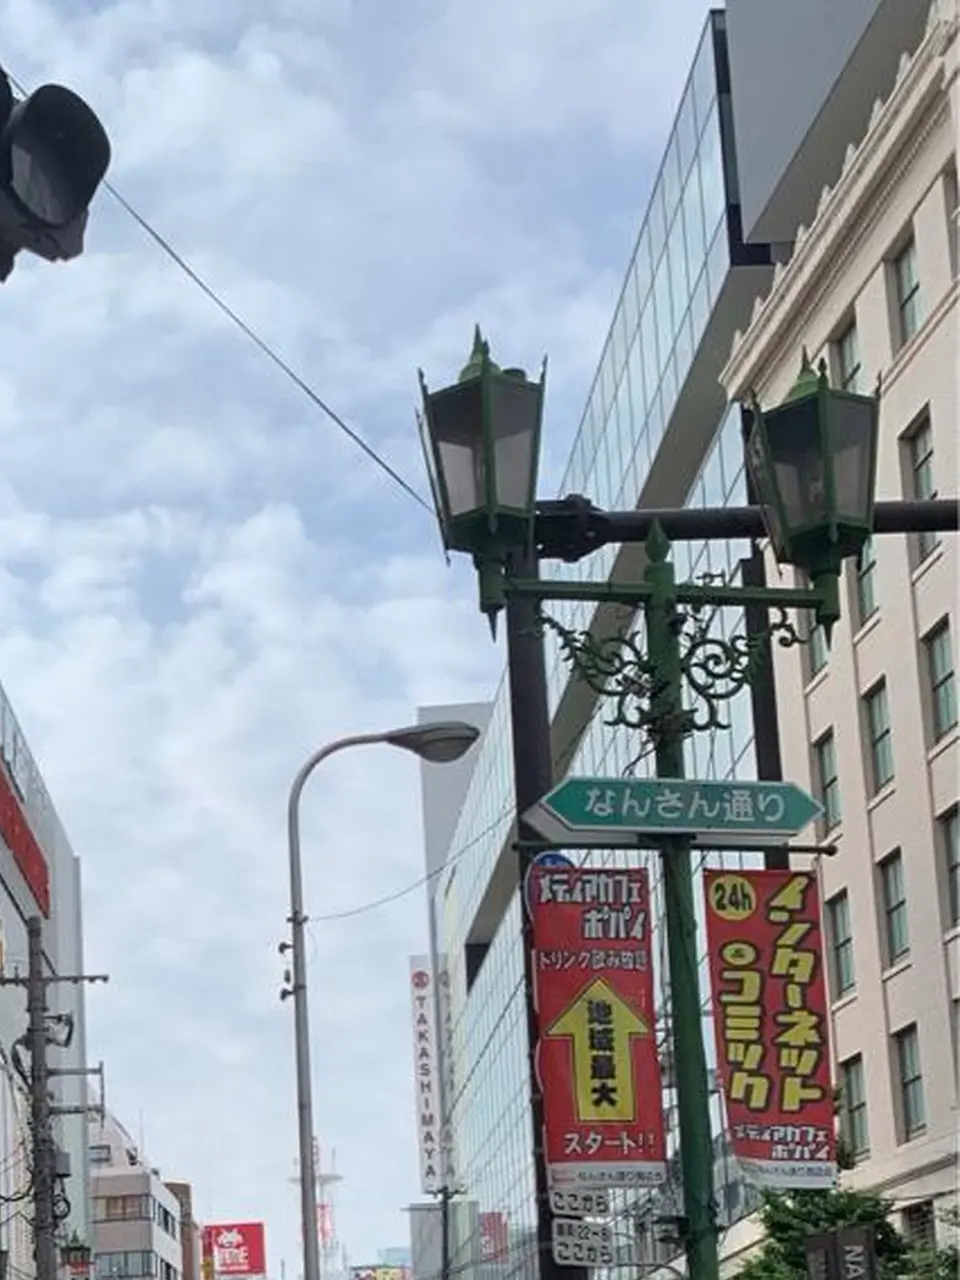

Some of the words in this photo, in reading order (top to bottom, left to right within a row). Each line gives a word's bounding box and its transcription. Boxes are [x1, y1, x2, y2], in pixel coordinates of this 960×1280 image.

[584, 788, 785, 822] なんさん通り
[712, 882, 756, 912] 24h
[768, 873, 823, 1113] インターネット
[415, 995, 437, 1178] TAKASHIMAYA
